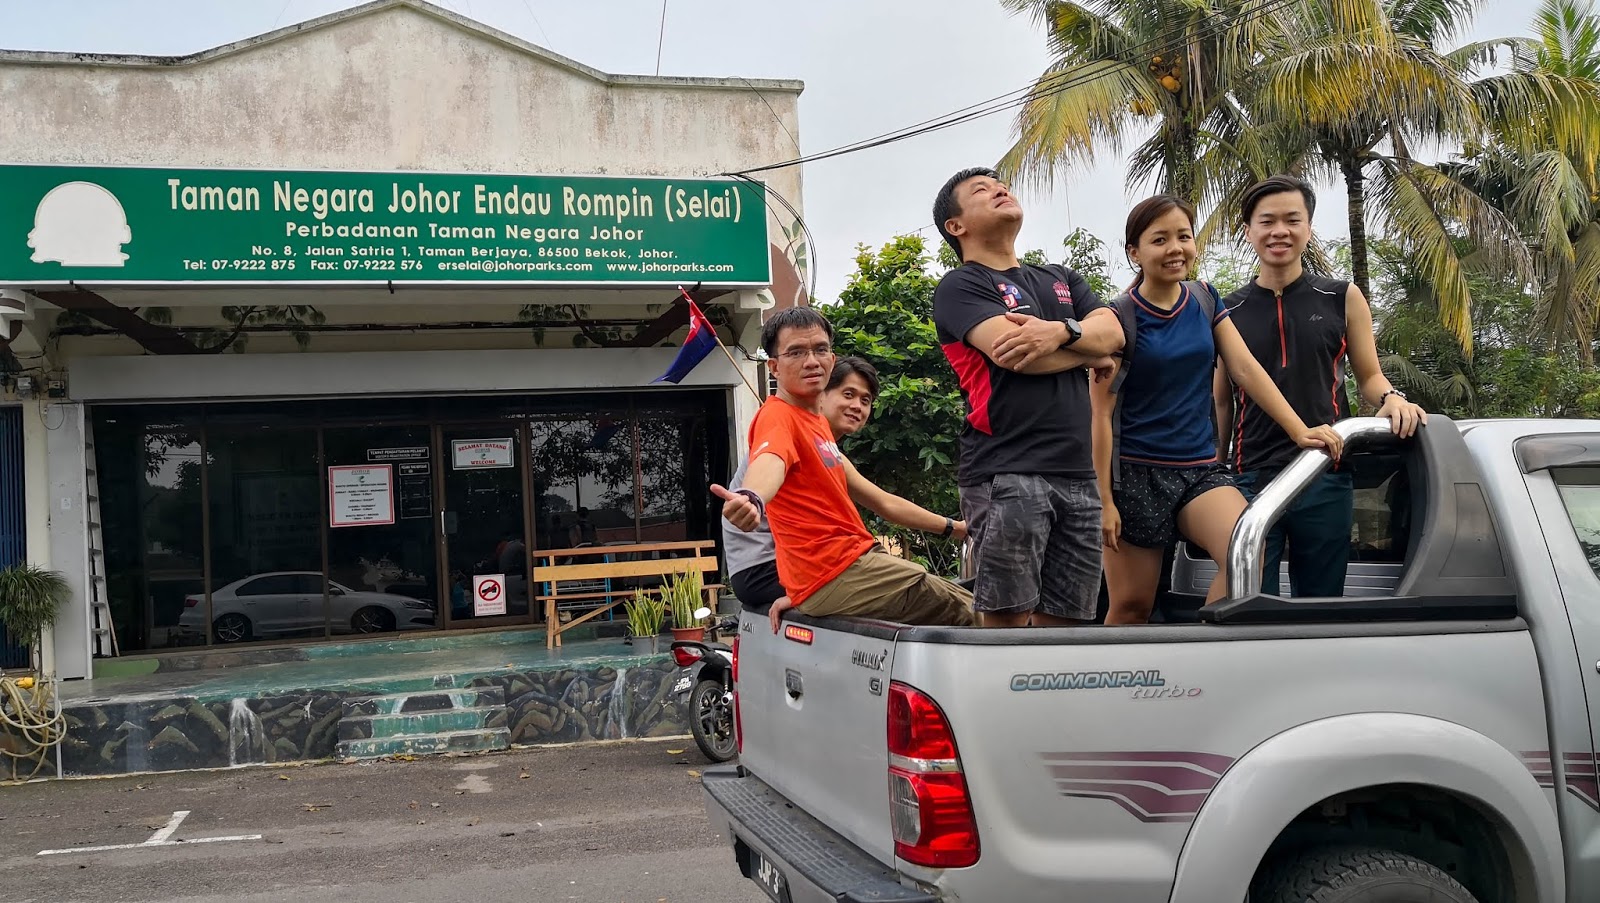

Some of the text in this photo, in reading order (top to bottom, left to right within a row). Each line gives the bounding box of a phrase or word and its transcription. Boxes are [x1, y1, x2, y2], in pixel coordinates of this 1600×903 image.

[167, 178, 741, 224] Taman Negara Johor Endau Rompin (Selai)
[286, 221, 644, 243] Perbadanan Taman Negara Johor
[251, 245, 678, 259] No. 8, Jalan Satria 1, Taman Berjaya, 86500 Bekok, Johor.
[182, 259, 734, 274] Tel: 07-9222 875 Fax: 07-9222 576 erselai@johorparks.com www.johorparks.com
[457, 443, 483, 452] SELAMAT
[852, 648, 885, 672] HILUX
[1010, 670, 1165, 691] COMMONRAIL
[1131, 685, 1202, 700] turbo
